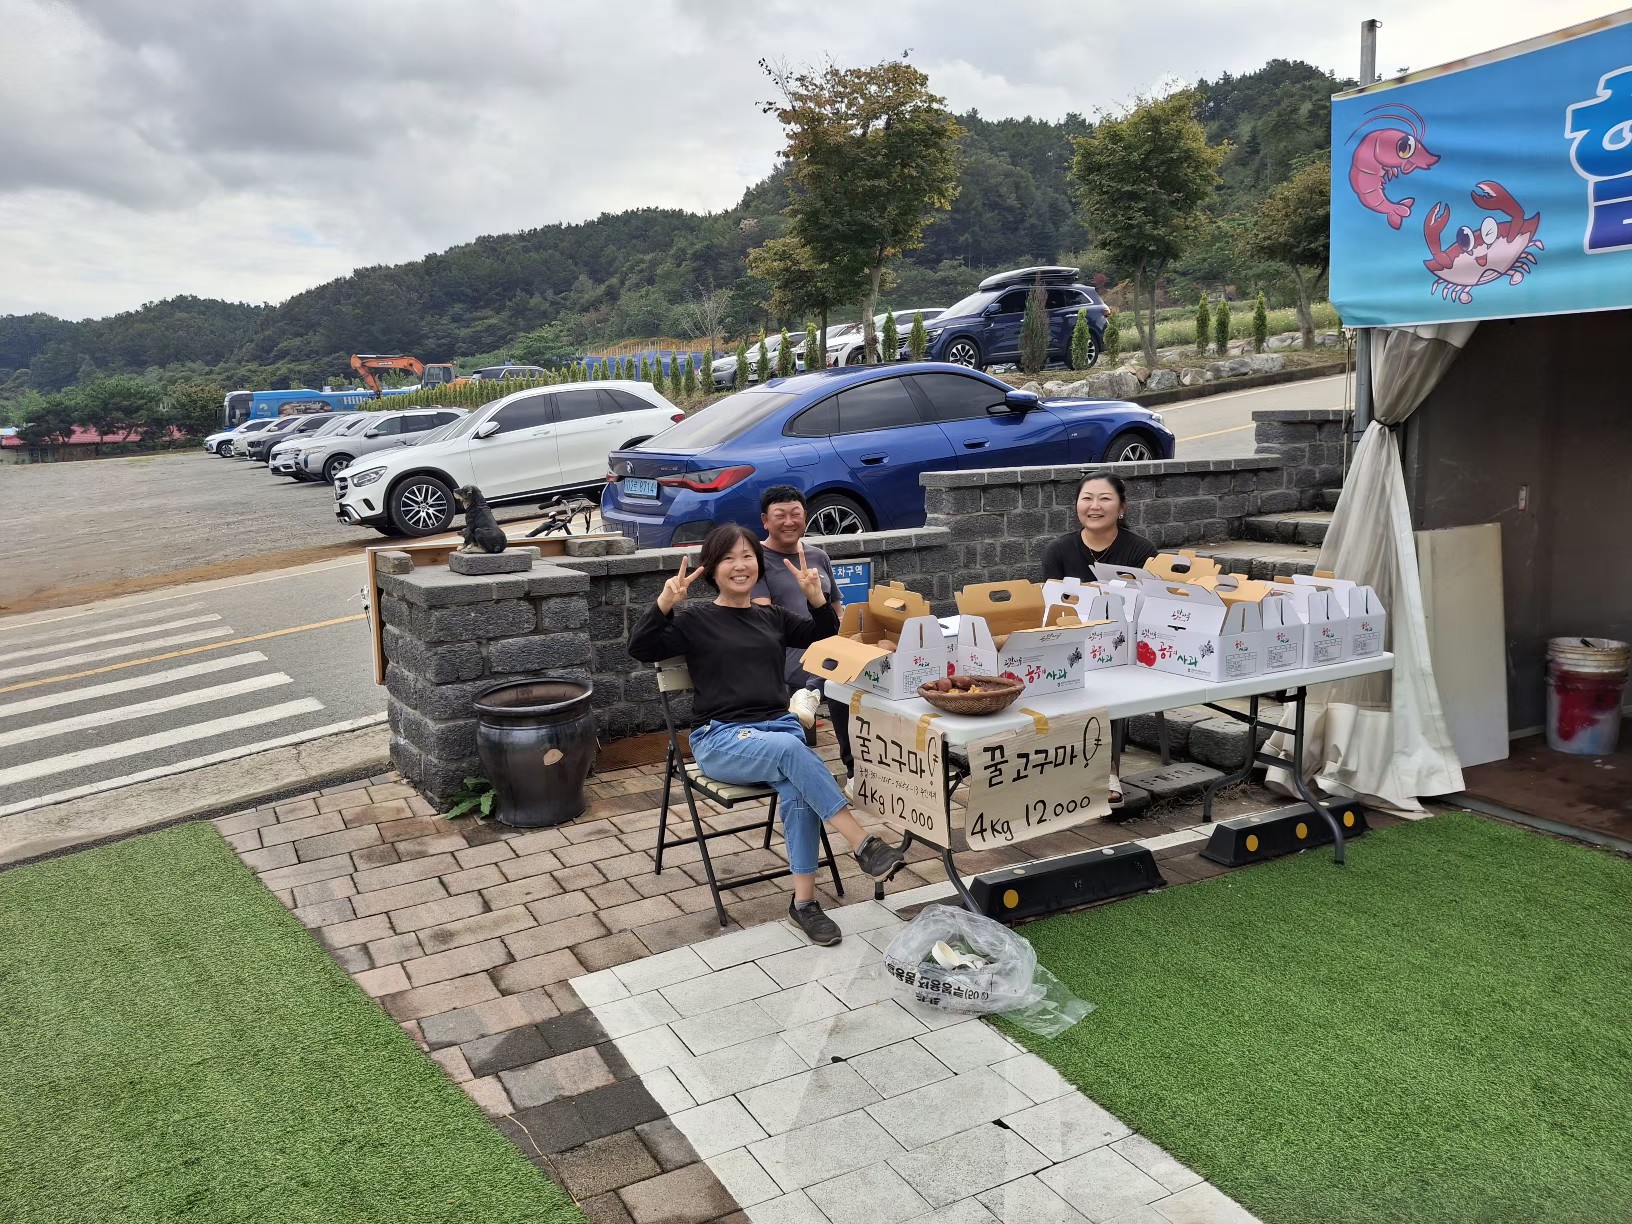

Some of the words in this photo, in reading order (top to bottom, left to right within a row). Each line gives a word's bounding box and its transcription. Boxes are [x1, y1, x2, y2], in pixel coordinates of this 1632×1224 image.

[1177, 652, 1199, 668] 사과
[1046, 668, 1068, 681] 사과
[1025, 796, 1091, 827] 12.000
